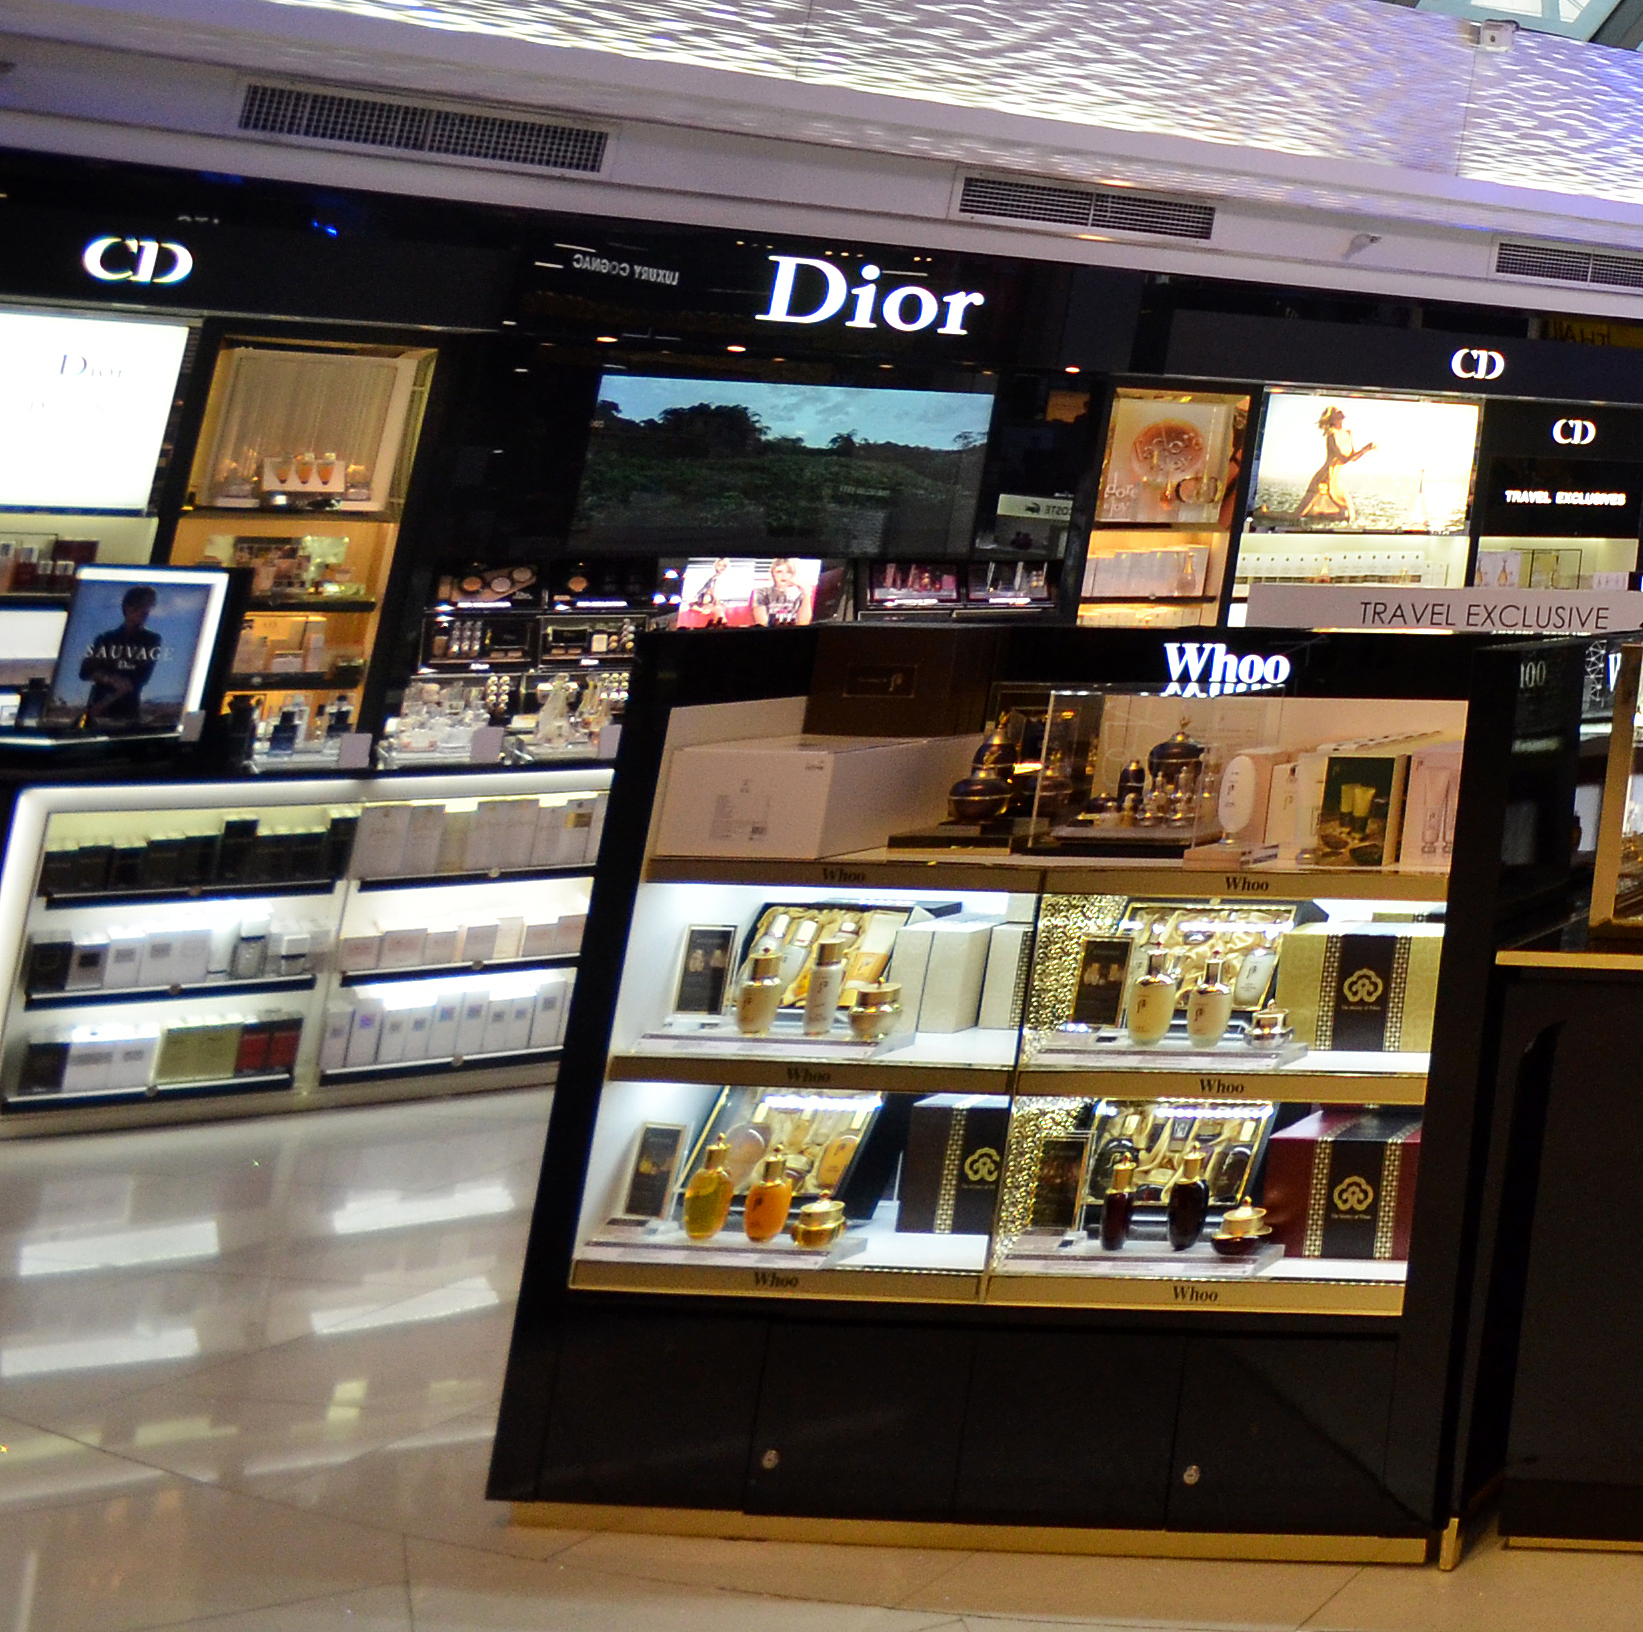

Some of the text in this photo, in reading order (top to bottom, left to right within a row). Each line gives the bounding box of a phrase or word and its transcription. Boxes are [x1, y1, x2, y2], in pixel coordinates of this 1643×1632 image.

[755, 255, 985, 336] Dior
[1505, 490, 1551, 504] TRAVEL
[1360, 601, 1609, 631] TRAVEL EXCLUSIVE
[85, 644, 174, 661] SAUVAGE
[1163, 642, 1291, 685] Whoo
[822, 868, 866, 884] Whoo
[1225, 876, 1270, 892] Whoo
[785, 1066, 830, 1084] Whoo
[1200, 1078, 1245, 1095] Whoo
[753, 1270, 799, 1288] Whoo
[1172, 1285, 1219, 1302] Whoo
